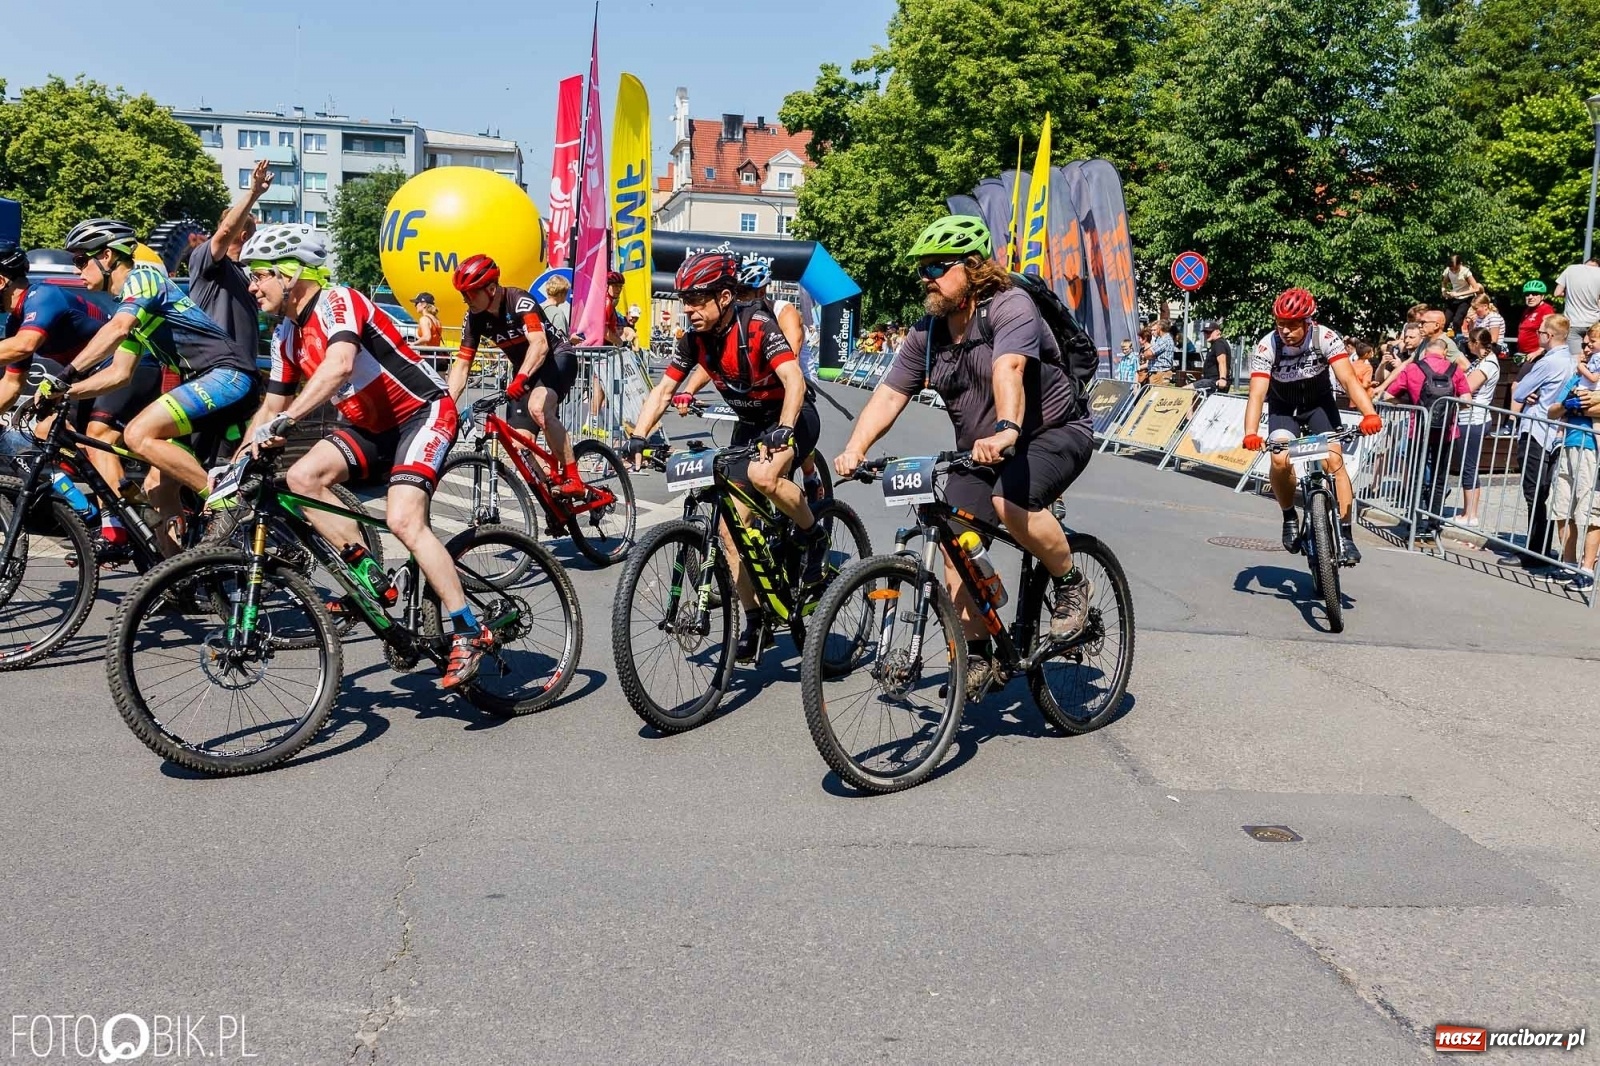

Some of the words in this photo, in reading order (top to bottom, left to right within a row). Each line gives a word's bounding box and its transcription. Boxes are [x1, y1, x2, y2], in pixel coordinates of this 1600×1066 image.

[418, 251, 458, 273] FM
[839, 308, 851, 340] atelier
[838, 340, 849, 363] bike
[190, 382, 217, 410] NGK
[1296, 443, 1320, 453] 1227
[674, 459, 704, 476] 1744
[890, 472, 923, 490] 1348
